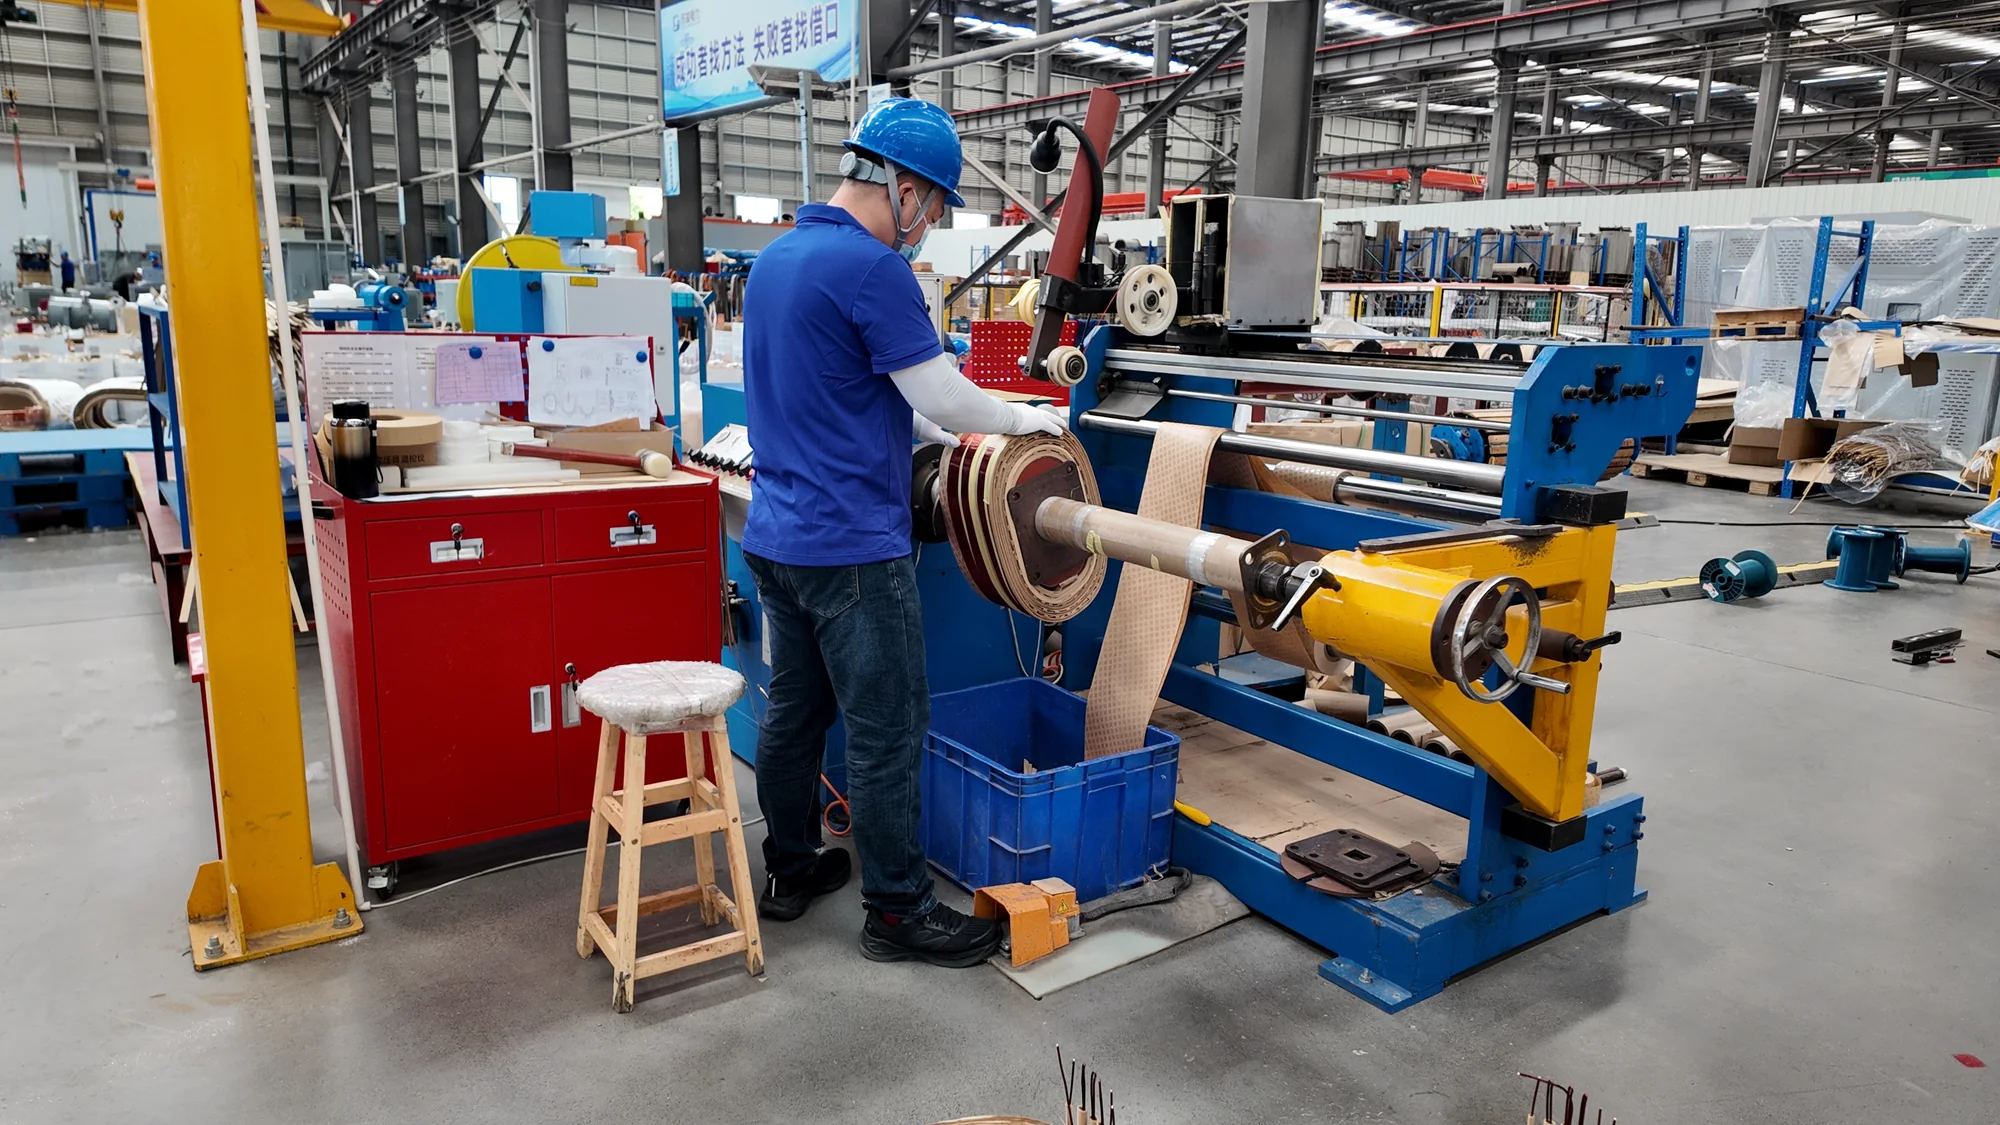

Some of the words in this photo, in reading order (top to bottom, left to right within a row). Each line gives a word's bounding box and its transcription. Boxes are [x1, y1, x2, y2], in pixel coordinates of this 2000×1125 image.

[675, 31, 745, 83] 成功者找方法
[753, 3, 838, 62] 失败者找借口
